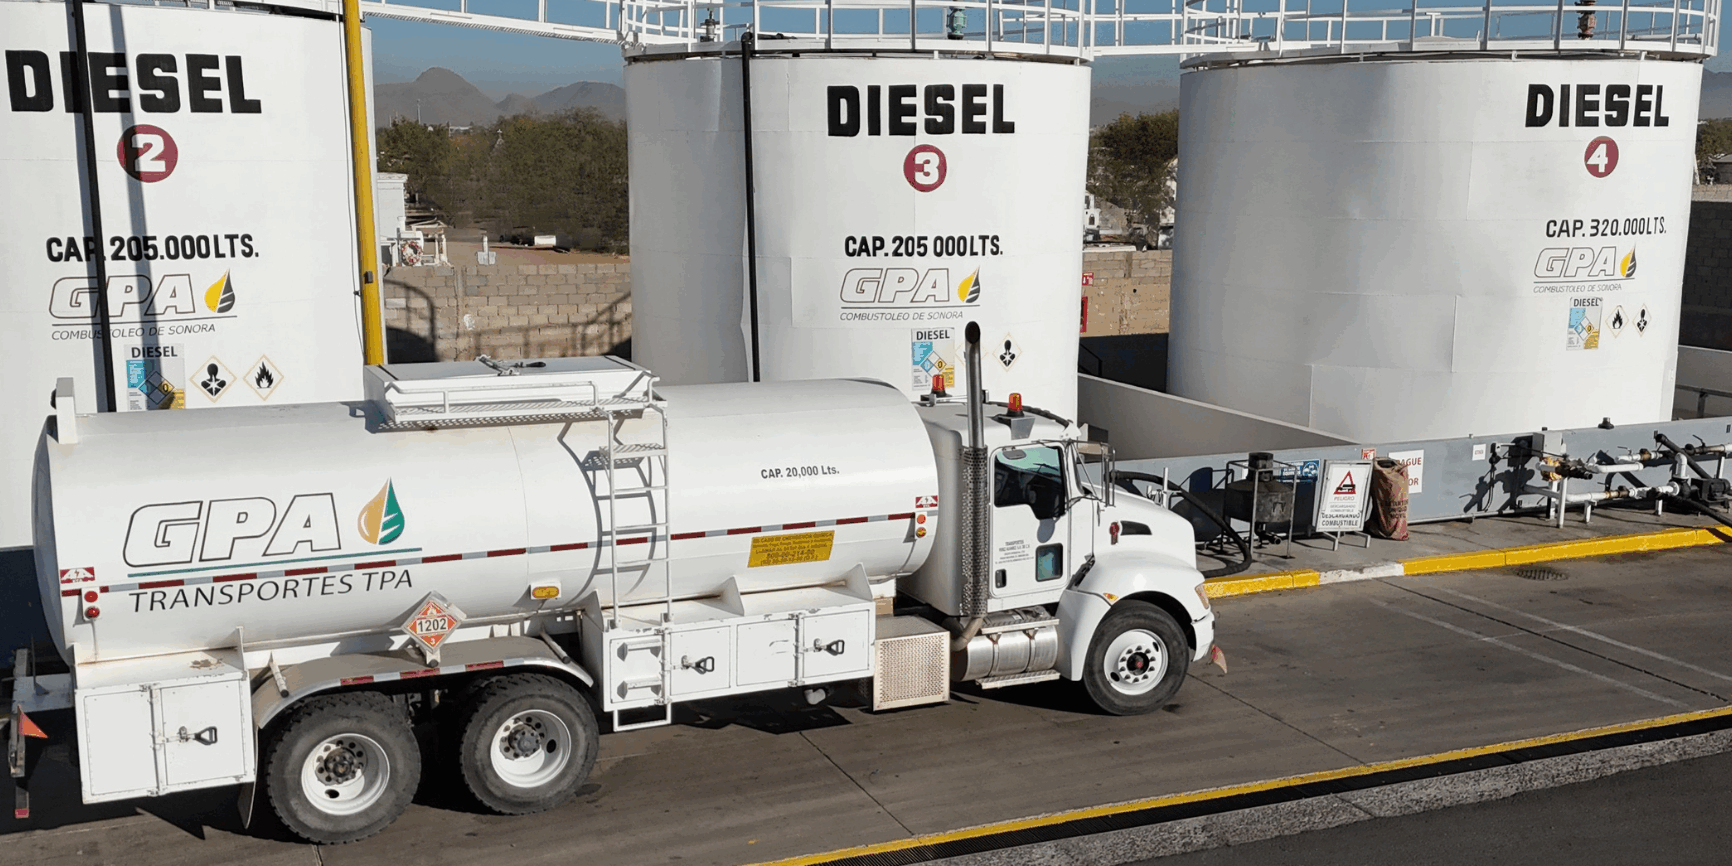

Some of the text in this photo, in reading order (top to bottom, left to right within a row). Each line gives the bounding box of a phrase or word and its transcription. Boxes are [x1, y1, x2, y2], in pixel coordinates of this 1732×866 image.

[5, 50, 262, 114] DIESEL
[827, 84, 1015, 136] DIESEL
[1525, 84, 1669, 127] DIESEL
[131, 133, 166, 172] 2
[1587, 144, 1608, 172] 4
[914, 152, 939, 185] 3
[1546, 219, 1585, 238] CAP.
[845, 236, 889, 257] CAP.
[1534, 246, 1616, 278] GPA
[49, 274, 195, 318] GPA
[840, 268, 950, 303] GPA
[1533, 285, 1585, 293] COMBUSTOLEO
[1587, 284, 1595, 292] DE
[840, 311, 963, 321] COMBUSTOLEO DE SONORA
[1574, 298, 1599, 306] DIESEL
[52, 324, 215, 340] COMBUSOLEO DE SONORA
[917, 330, 950, 340] DIESEL
[132, 346, 178, 358] DIESEL
[761, 465, 839, 479] CAP. 20,000 Lts.
[123, 493, 341, 568] GPA
[129, 568, 412, 612] TRANSPORTES TPA
[418, 618, 446, 632] 1202
